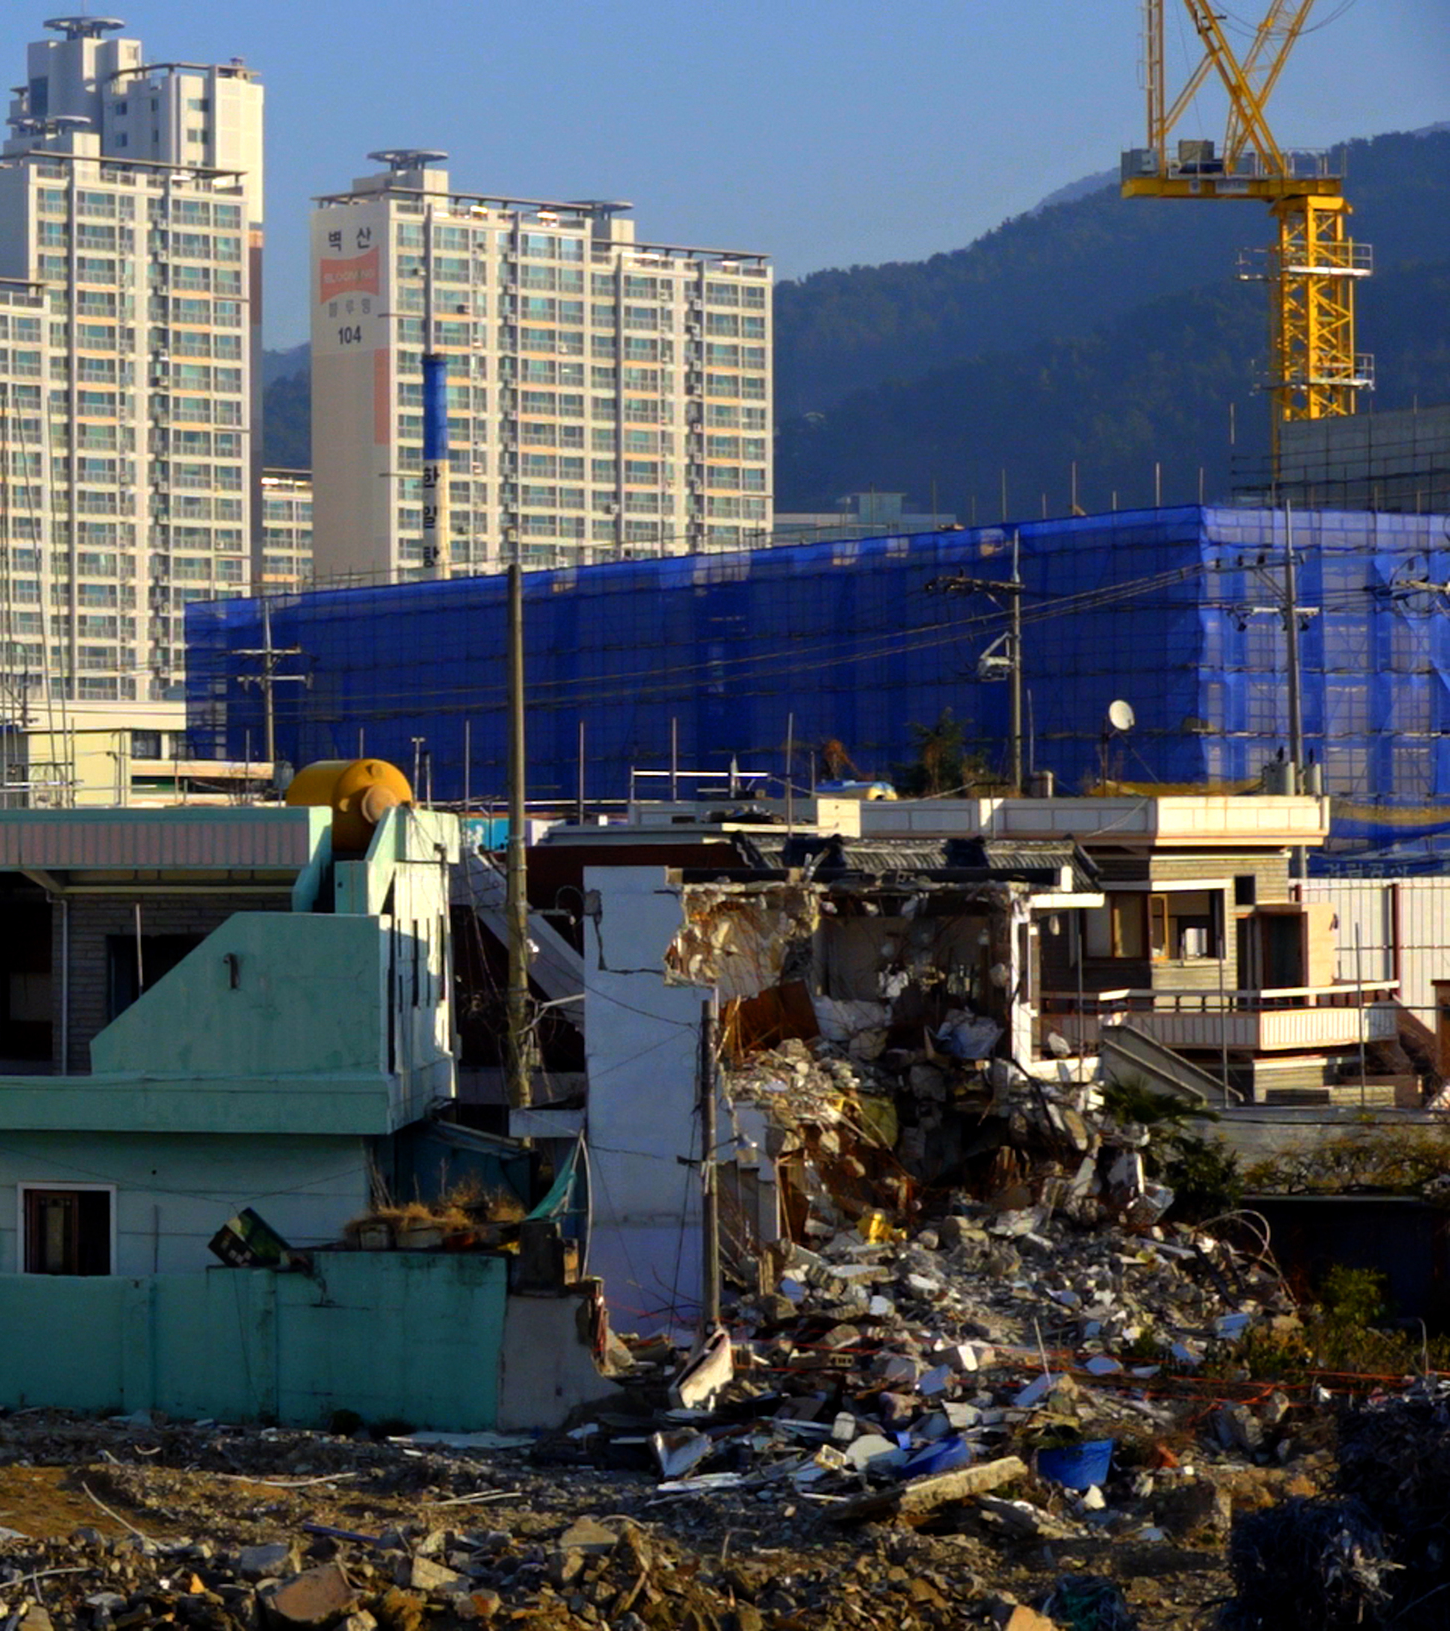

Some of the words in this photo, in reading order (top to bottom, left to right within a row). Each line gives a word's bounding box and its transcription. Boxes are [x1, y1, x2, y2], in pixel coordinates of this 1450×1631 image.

[328, 226, 371, 252] 벽산
[338, 325, 362, 345] 104
[422, 464, 441, 569] 한일탕
